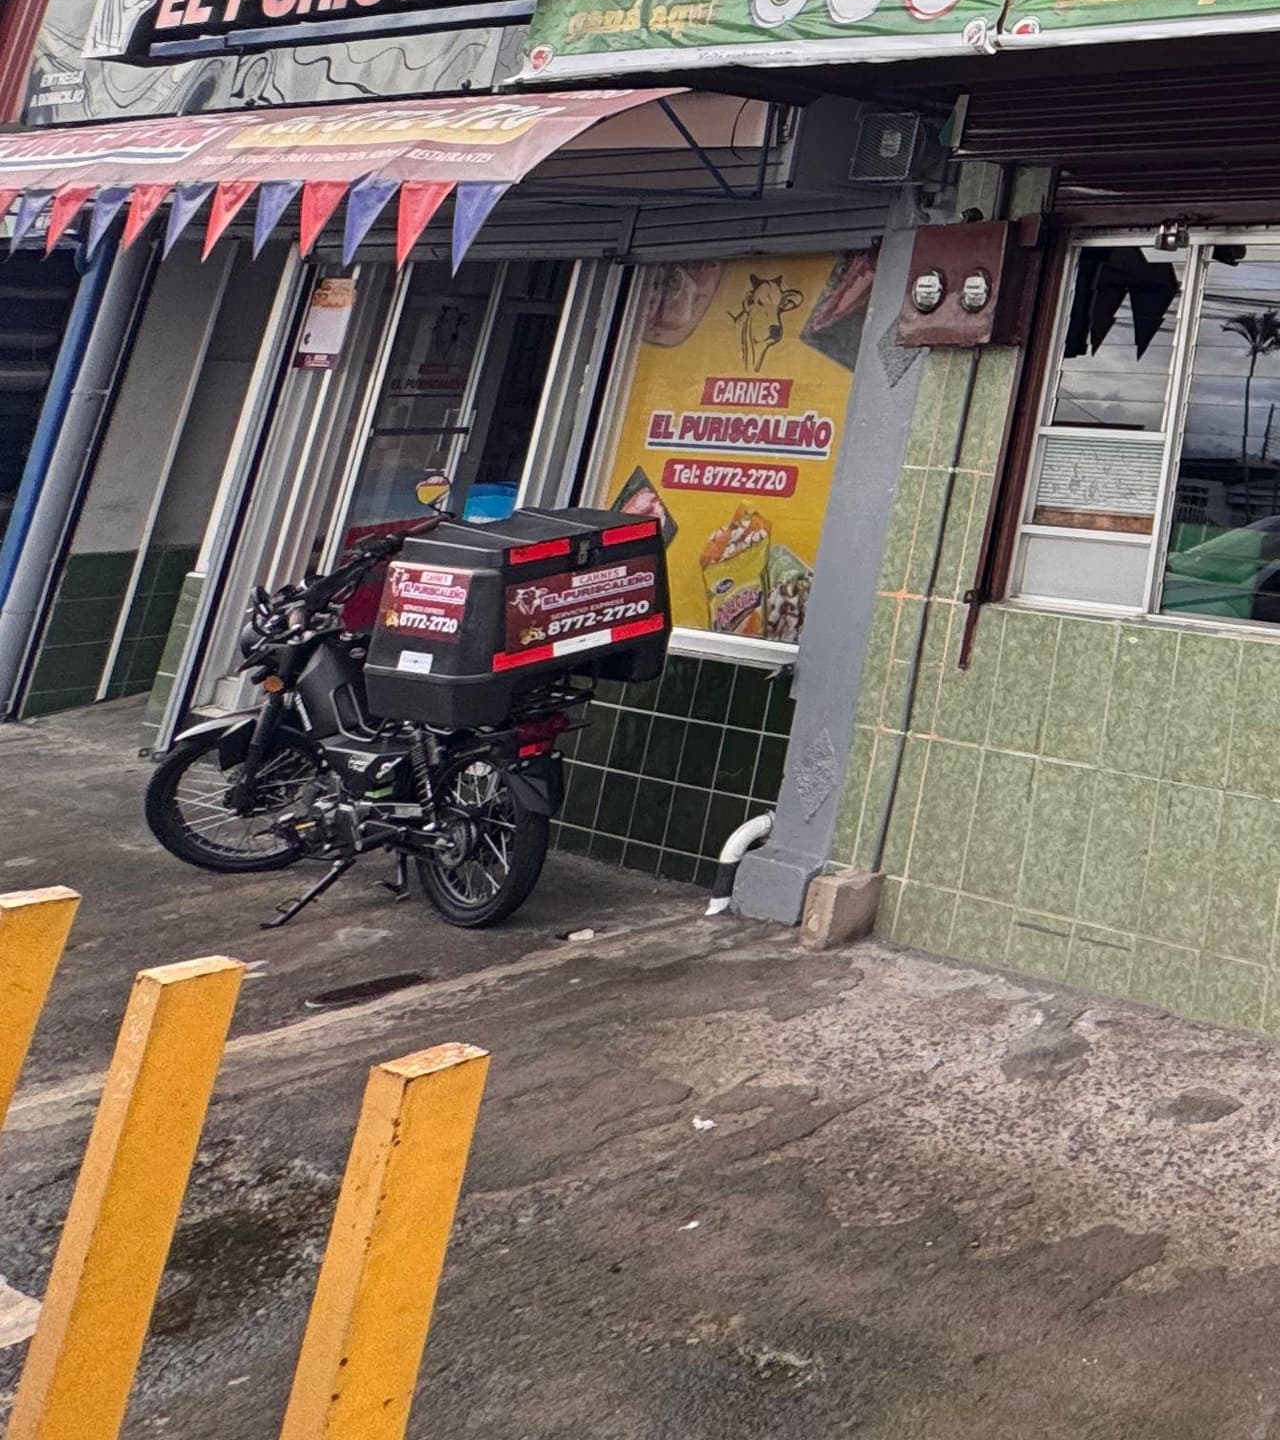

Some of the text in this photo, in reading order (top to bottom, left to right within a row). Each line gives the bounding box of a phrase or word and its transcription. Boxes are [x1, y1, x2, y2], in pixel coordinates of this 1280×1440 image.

[712, 379, 781, 406] CARNES
[649, 413, 832, 449] EL PURISCALEÑO
[672, 463, 788, 492] Tel: 8772-2720
[543, 572, 653, 606] EL PURISCALEÑO
[579, 568, 621, 584] CARNES
[400, 611, 459, 634] 8772-2720
[547, 600, 650, 635] 8772-2720
